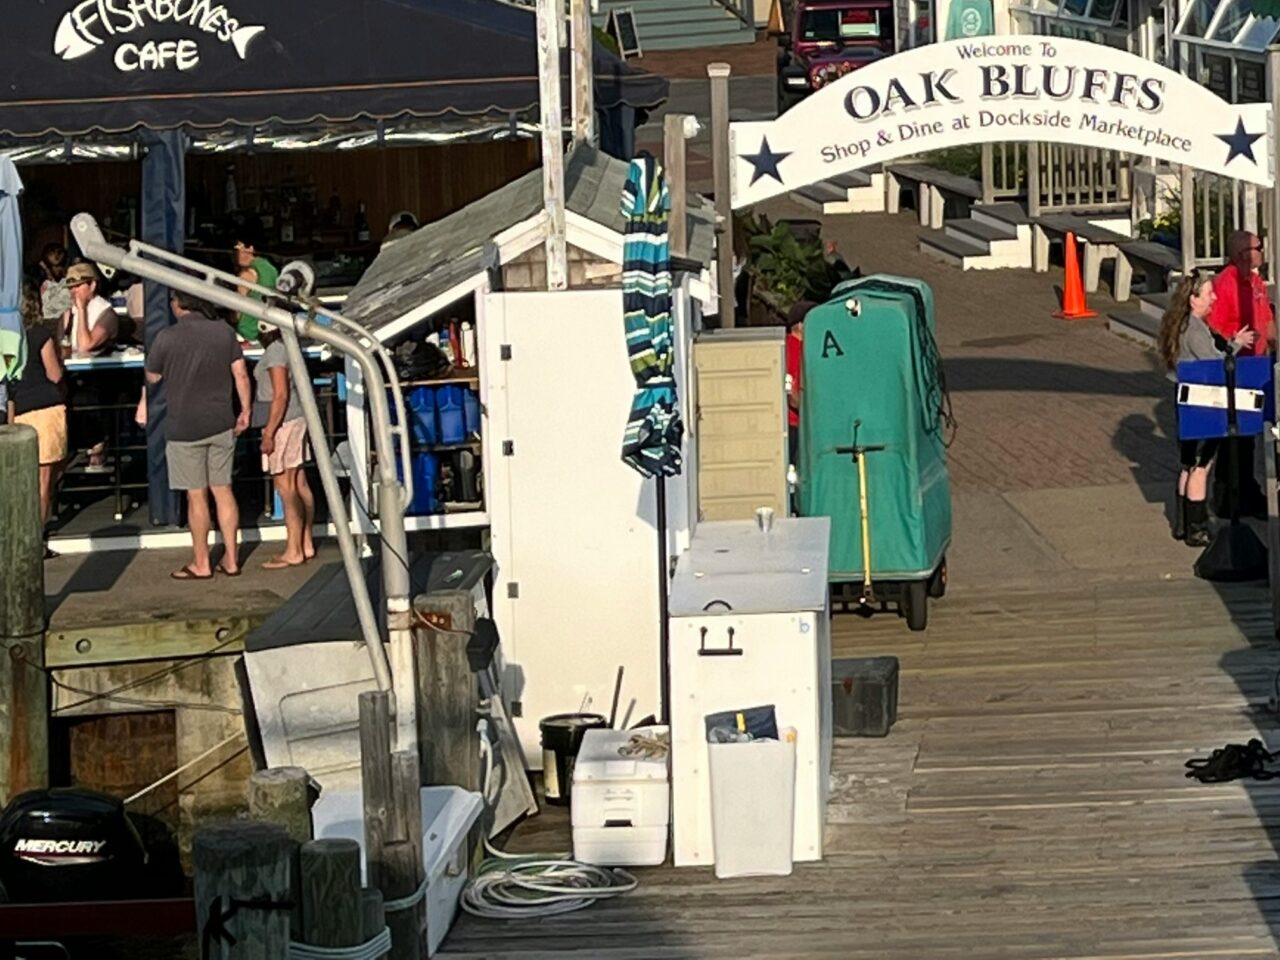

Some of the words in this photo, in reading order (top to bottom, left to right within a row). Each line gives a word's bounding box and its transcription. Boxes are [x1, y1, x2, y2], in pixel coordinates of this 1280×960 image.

[114, 40, 199, 71] CAFE
[956, 42, 1032, 60] Welcome
[1039, 41, 1057, 58] To
[844, 68, 963, 122] OAK
[978, 64, 1165, 114] BLUFFS
[820, 139, 871, 163] Shop
[876, 130, 894, 146] &
[898, 120, 944, 141] Dine
[952, 114, 971, 130] at
[979, 109, 1072, 128] Dockside
[1079, 113, 1192, 152] Marketplace
[821, 329, 844, 358] A
[14, 839, 107, 853] MERCURY
